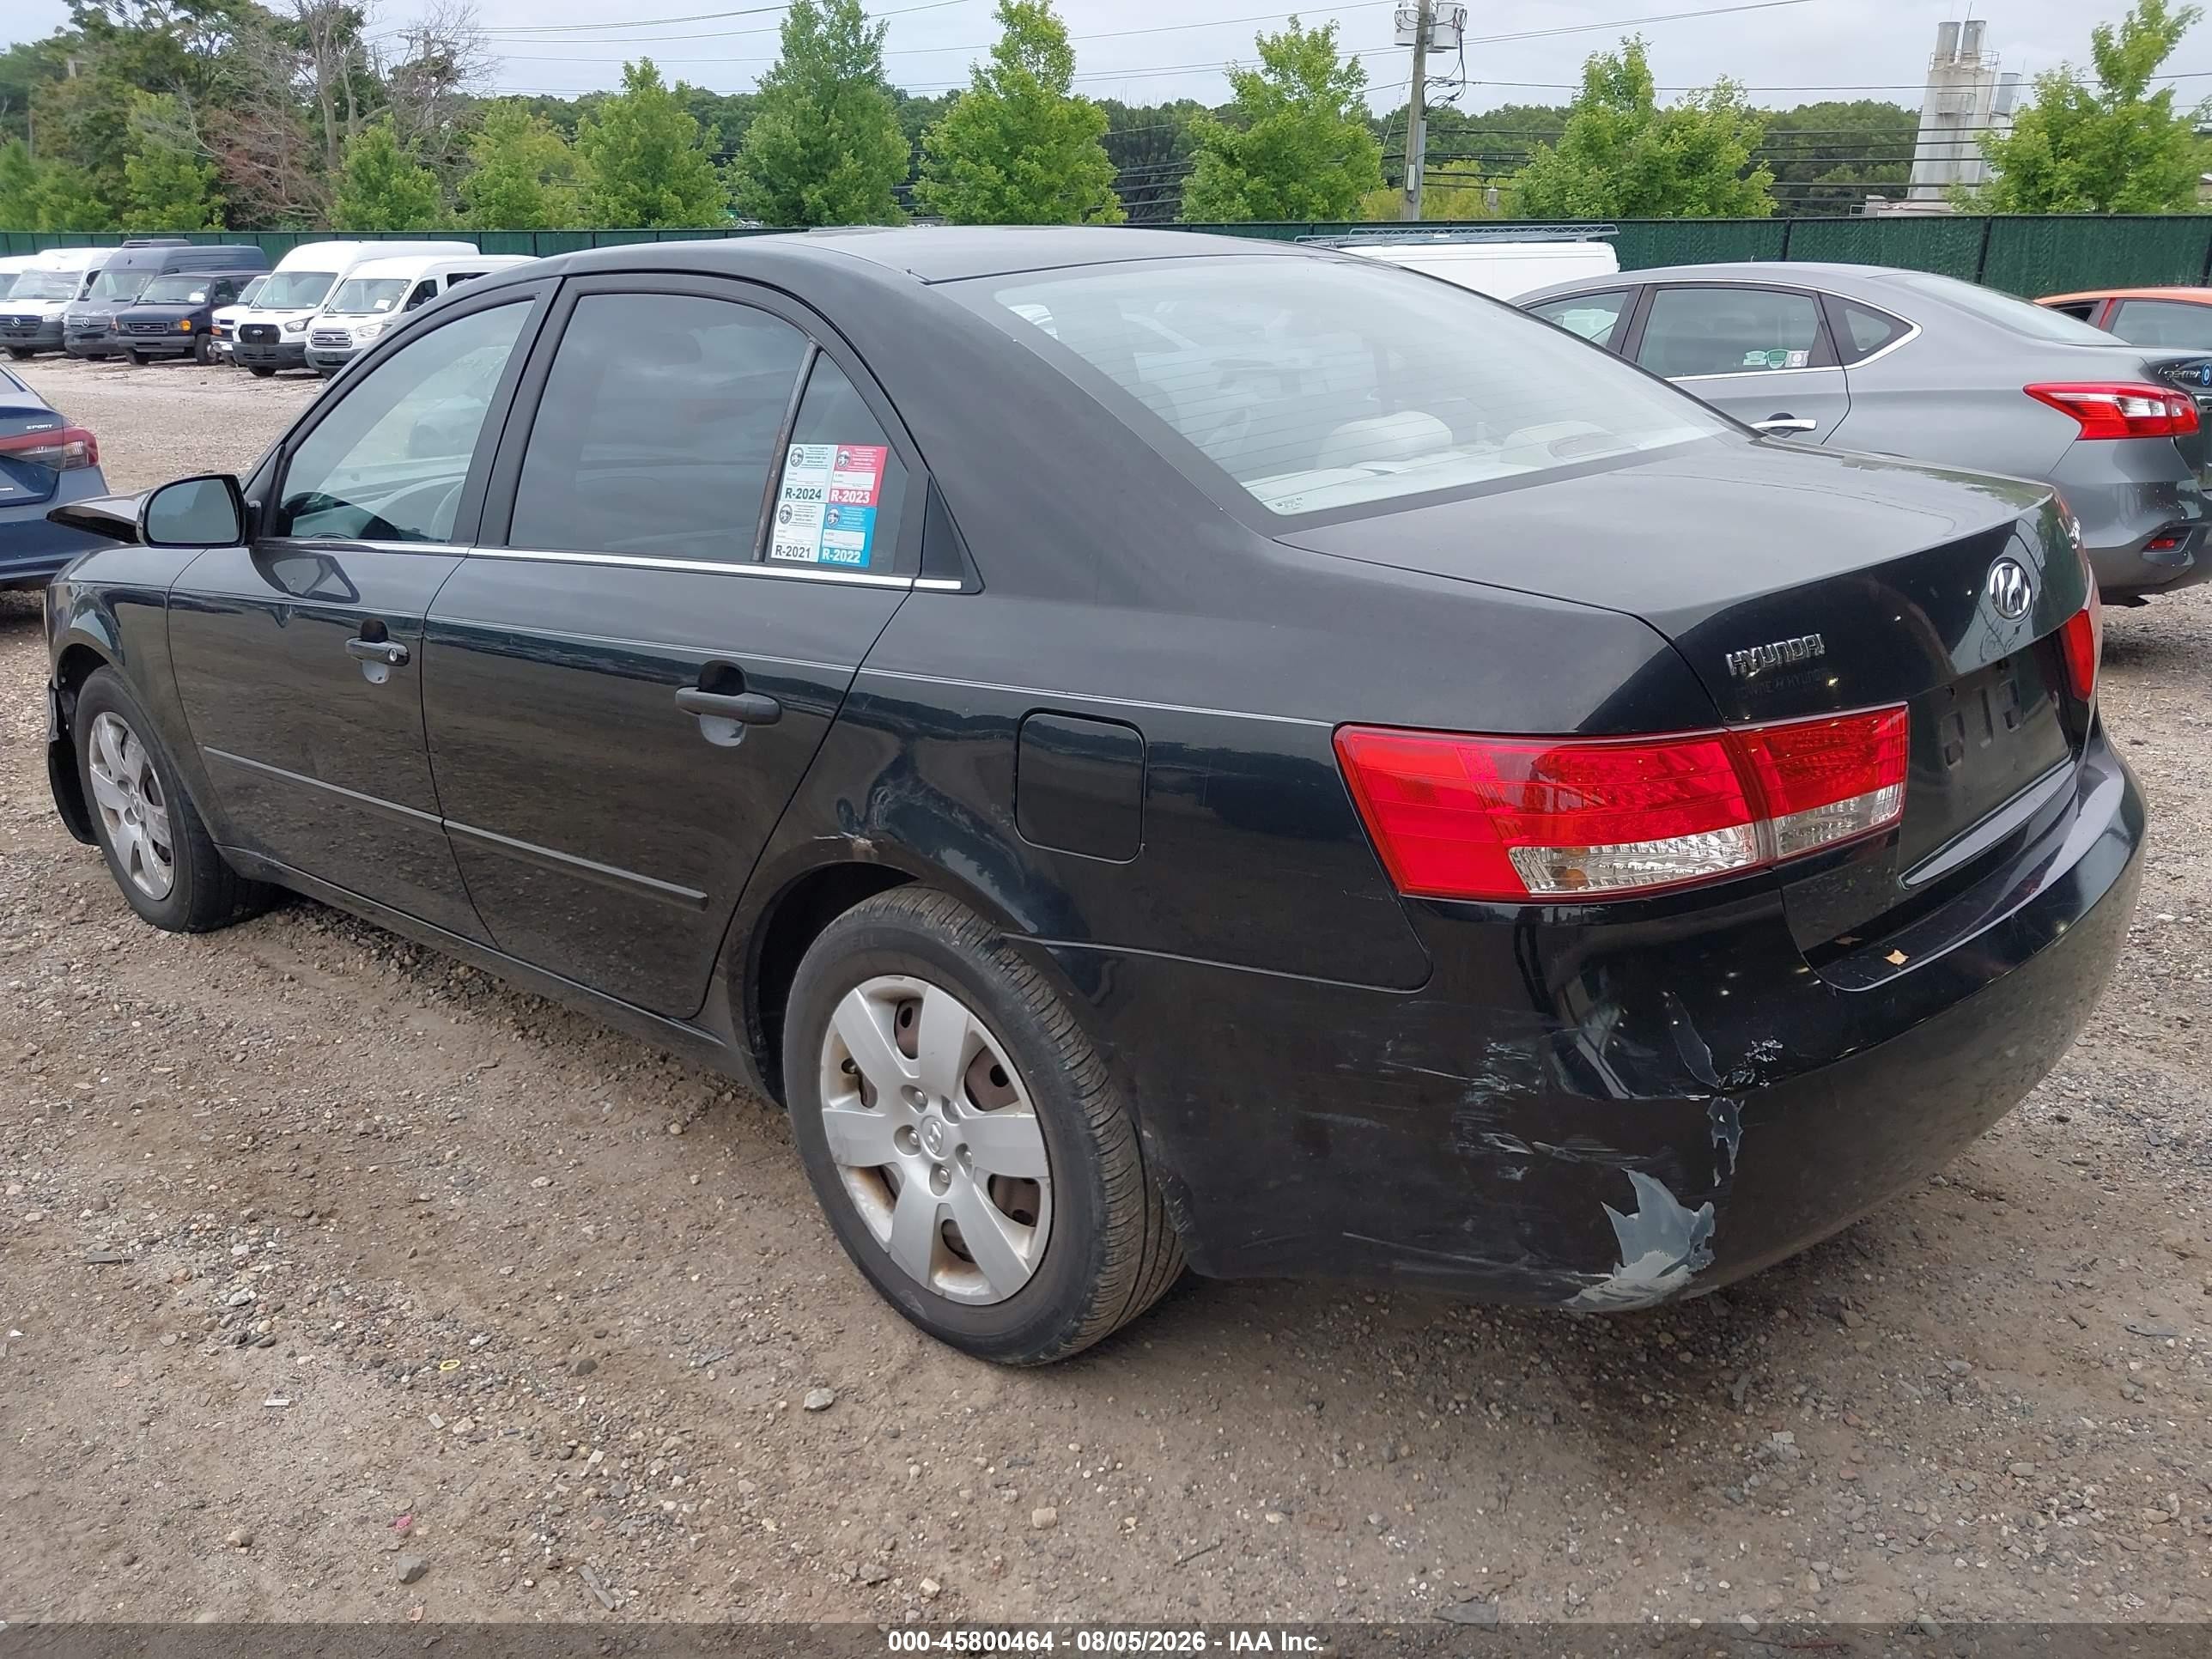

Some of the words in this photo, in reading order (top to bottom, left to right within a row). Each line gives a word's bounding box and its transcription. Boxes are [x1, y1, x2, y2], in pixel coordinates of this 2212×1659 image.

[785, 488, 822, 500] R-2024
[830, 489, 870, 503] R-2023
[775, 545, 811, 558] R-2021
[822, 548, 860, 563] R-2022
[1725, 634, 1825, 676] HYUNDAI
